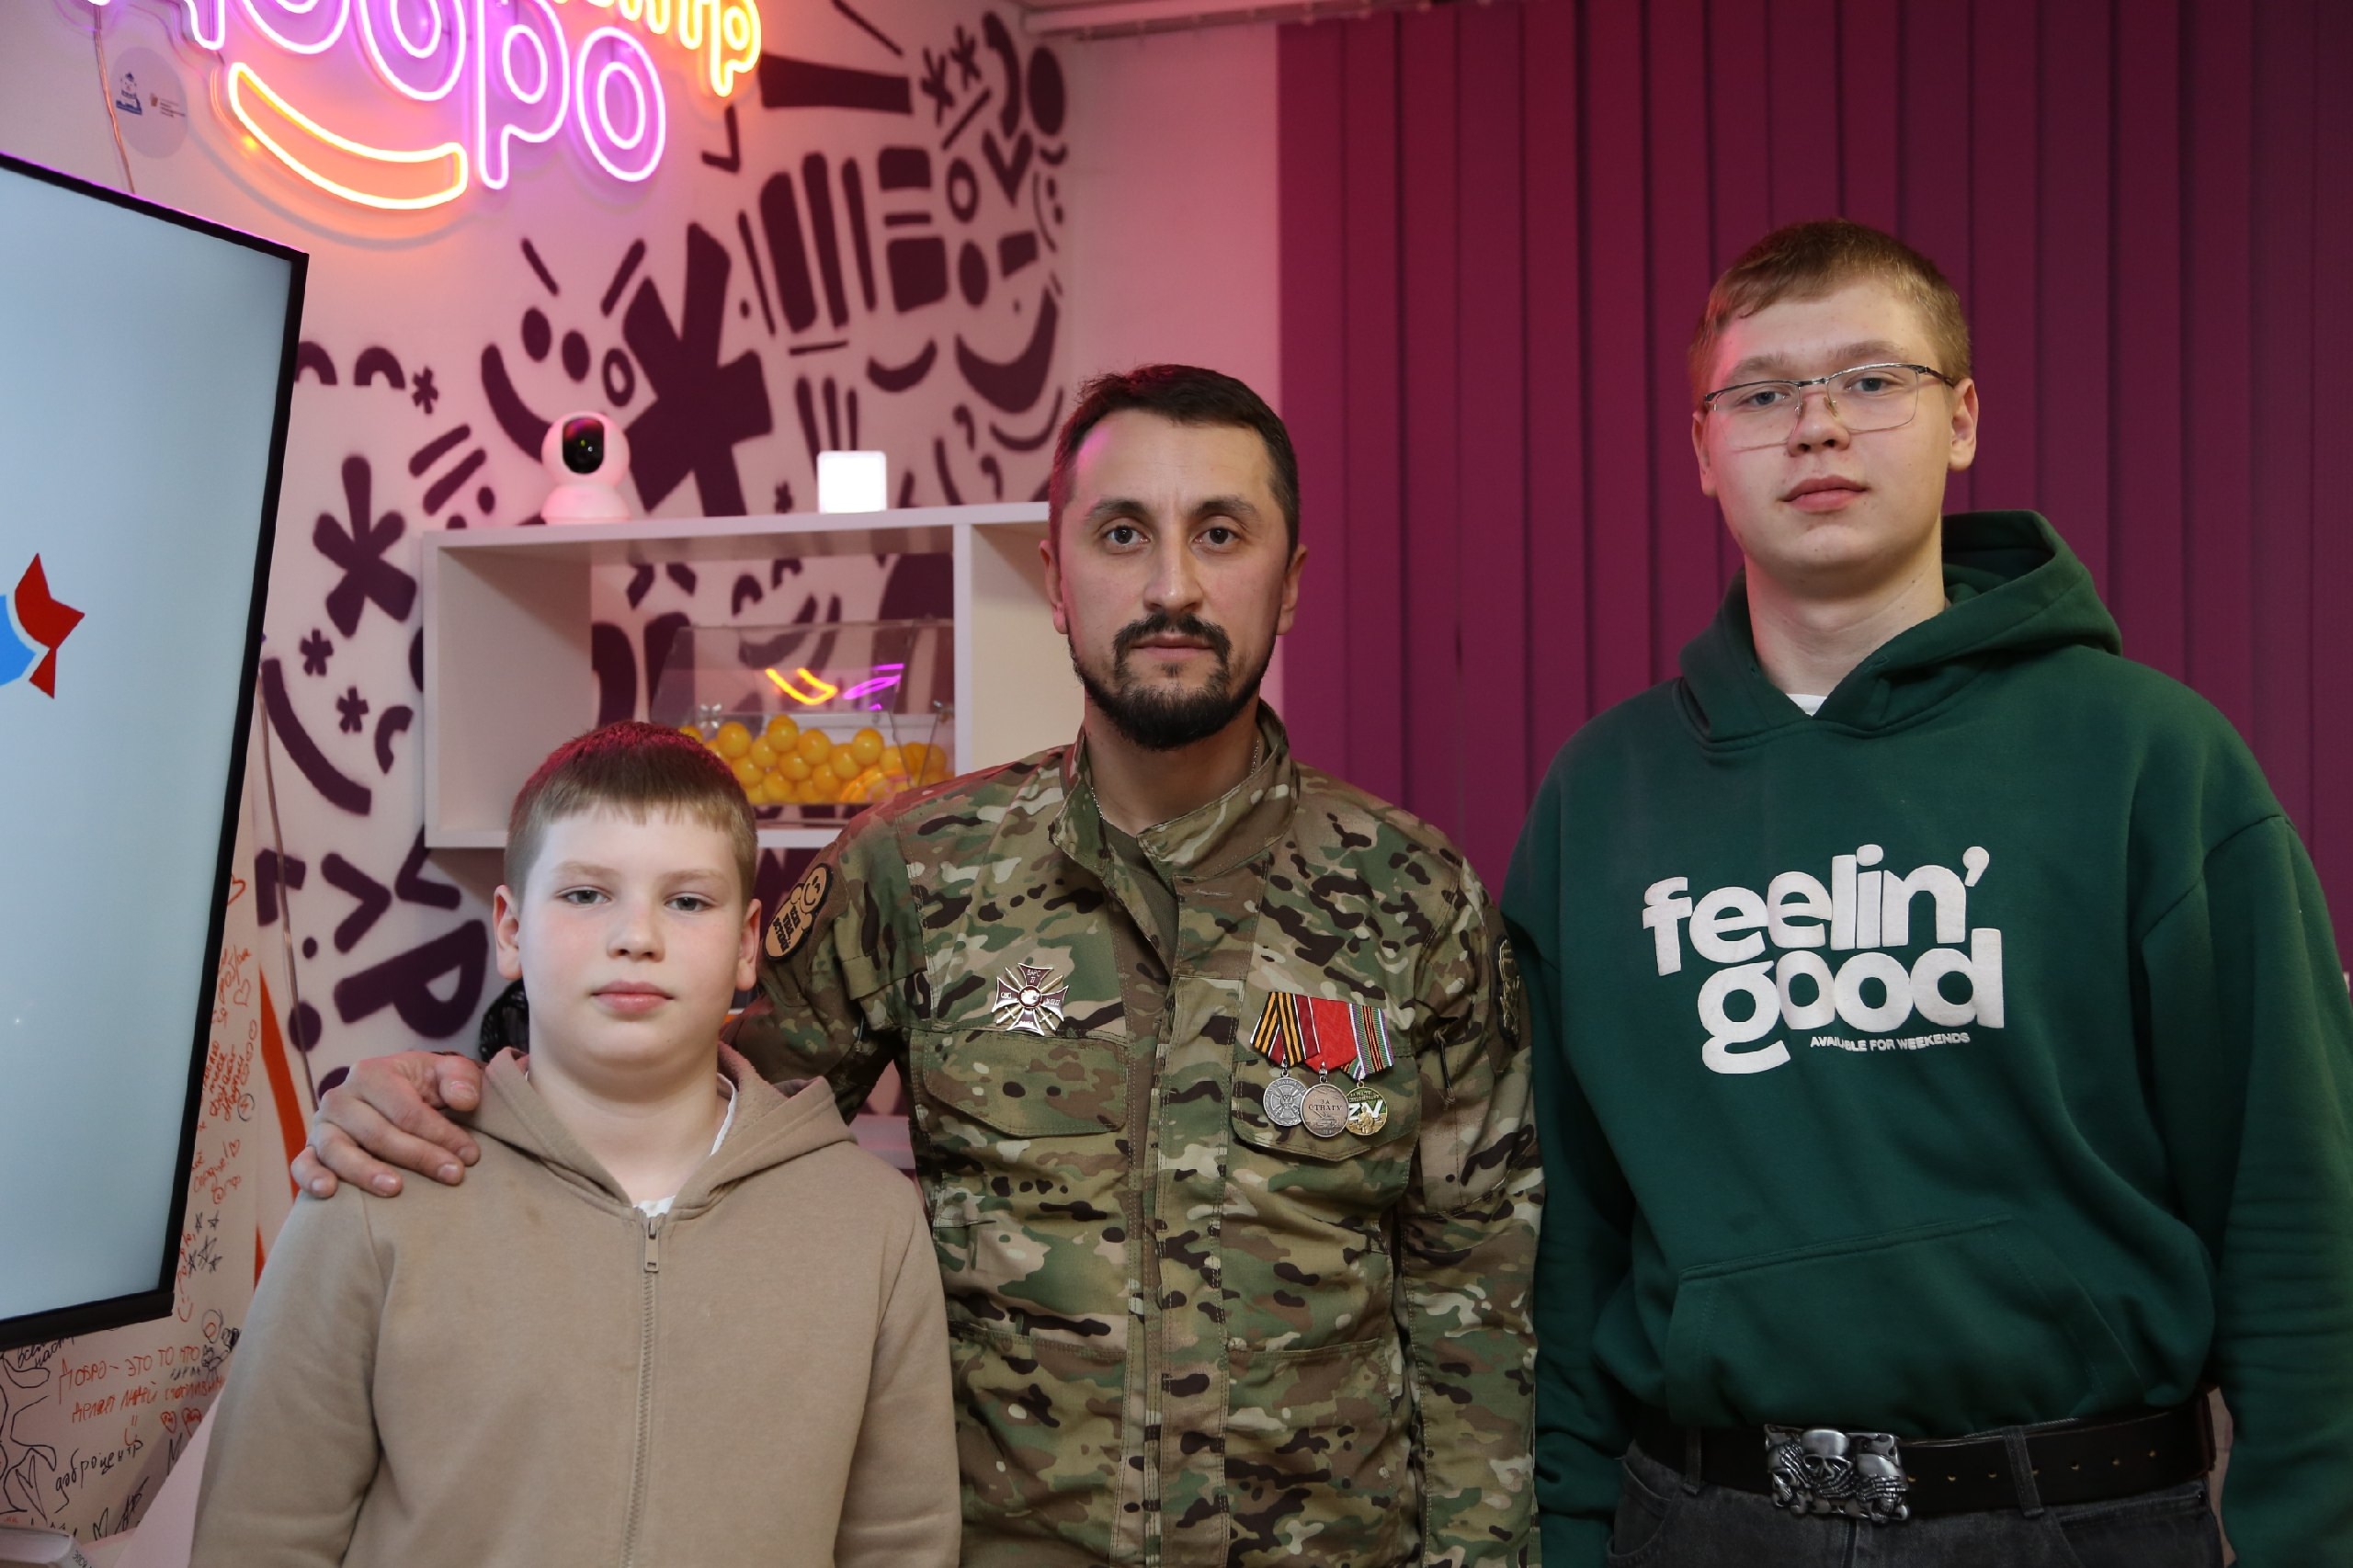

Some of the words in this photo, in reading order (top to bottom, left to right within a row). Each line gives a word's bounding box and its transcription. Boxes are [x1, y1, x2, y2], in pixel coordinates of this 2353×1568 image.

[1643, 844, 1990, 976] feelin'
[1697, 927, 2005, 1074] good
[1870, 1039, 1895, 1051] FOR
[1897, 1032, 1971, 1051] WEEKENDS
